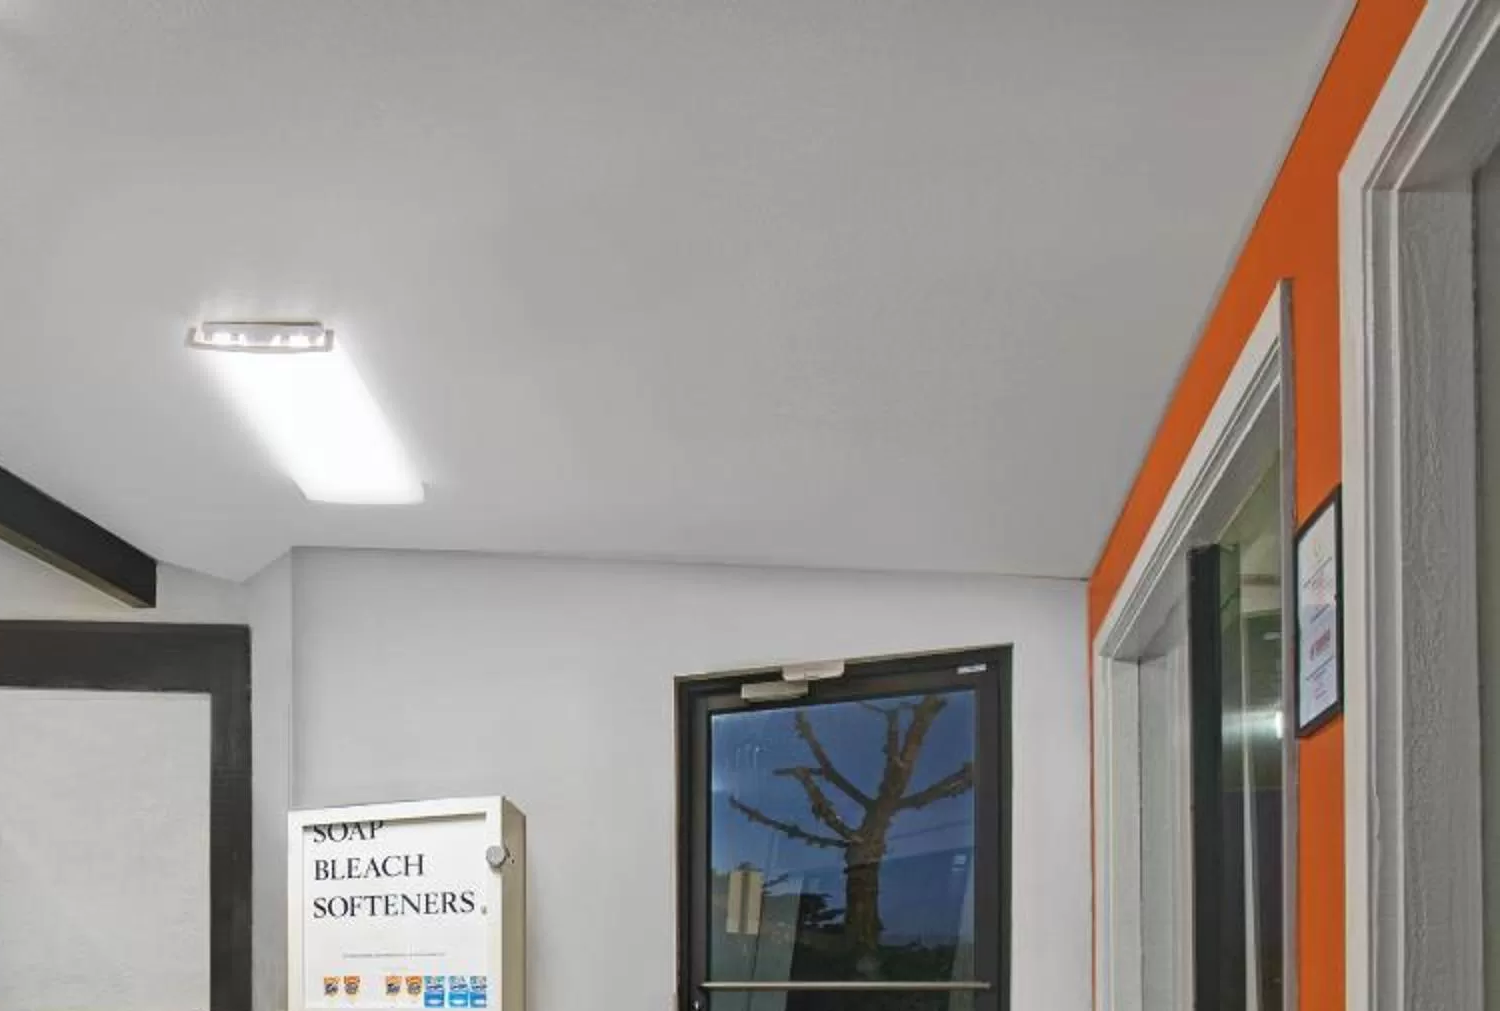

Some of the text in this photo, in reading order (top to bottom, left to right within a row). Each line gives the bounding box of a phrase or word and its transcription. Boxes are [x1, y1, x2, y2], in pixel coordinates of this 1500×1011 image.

[313, 820, 383, 843] SOAP
[315, 854, 424, 881] BLEACH
[313, 891, 475, 919] SOFTENERS
